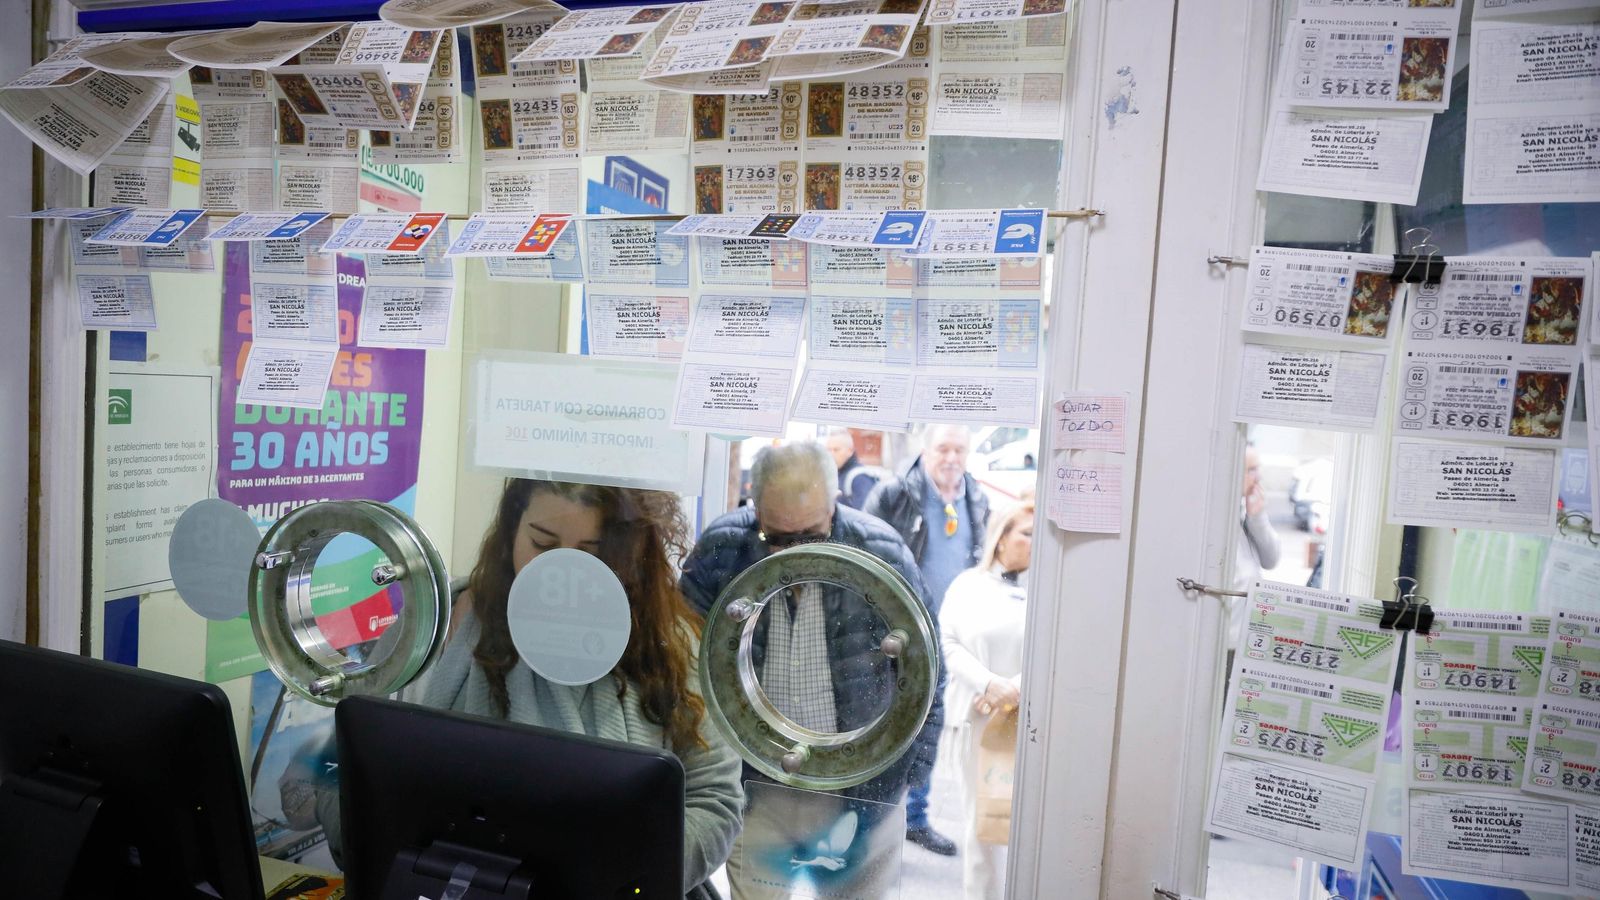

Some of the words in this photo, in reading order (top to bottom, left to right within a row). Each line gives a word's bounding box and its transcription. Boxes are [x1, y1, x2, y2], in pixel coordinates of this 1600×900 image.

[957, 10, 1017, 18] 82011
[694, 20, 744, 32] 17363
[1523, 48, 1544, 56] SAN
[1548, 42, 1598, 54] NICOLÁS
[356, 52, 398, 61] 26466
[667, 59, 721, 72] 17363
[311, 76, 363, 86] 26466
[848, 84, 904, 99] 48352
[1322, 80, 1392, 96] 22145
[514, 100, 558, 113] 22435
[911, 125, 920, 133] 20
[1334, 136, 1376, 144] NICOLÁS
[1548, 134, 1598, 144] NICOLÁS
[727, 167, 776, 179] 17363
[844, 166, 901, 180] 48352
[815, 232, 871, 243] 13682
[470, 242, 515, 251] 20385
[933, 241, 990, 252] 13591
[1275, 309, 1341, 328] 07590
[1486, 310, 1521, 318] LOTERÍA
[1443, 321, 1515, 337] 19631
[1290, 368, 1330, 376] NICOLÁS
[1062, 400, 1102, 414] QUITAR
[1432, 401, 1471, 409] NACIONAL
[1059, 418, 1114, 432] TOLDO
[1432, 412, 1503, 429] 19631
[114, 442, 161, 452] establecimiento
[164, 441, 178, 449] tiene
[182, 440, 196, 449] hojas
[231, 431, 285, 471] 30
[295, 421, 389, 468] AÑOS
[124, 454, 168, 464] reclamaciones
[110, 469, 118, 477] las
[124, 468, 152, 477] personas
[157, 465, 197, 474] consumidoras
[1057, 467, 1098, 481] QUITAR
[1466, 467, 1511, 475] NICOLÁS
[124, 482, 135, 491] que
[136, 480, 145, 488] las
[230, 480, 254, 489] PARA
[255, 478, 267, 486] UN
[268, 475, 302, 486] MÁXIMO
[303, 476, 313, 484] DE
[320, 472, 364, 483] ACERTANTES
[1059, 483, 1085, 493] AIRE
[114, 508, 156, 519] establishment
[135, 534, 150, 542] users
[1274, 636, 1304, 647] Jueves
[1273, 646, 1339, 668] 21975
[1443, 662, 1477, 670] Jueves
[1444, 673, 1518, 691] 14907
[1259, 722, 1289, 733] Jueves
[1258, 733, 1325, 756] 21975
[1441, 753, 1473, 761] Jueves
[1442, 764, 1512, 782] 14907
[1563, 761, 1597, 773] Jueves
[1255, 783, 1274, 792] SAN
[1277, 788, 1319, 803] NICOLÁS
[1476, 817, 1522, 827] NICOLÁS
